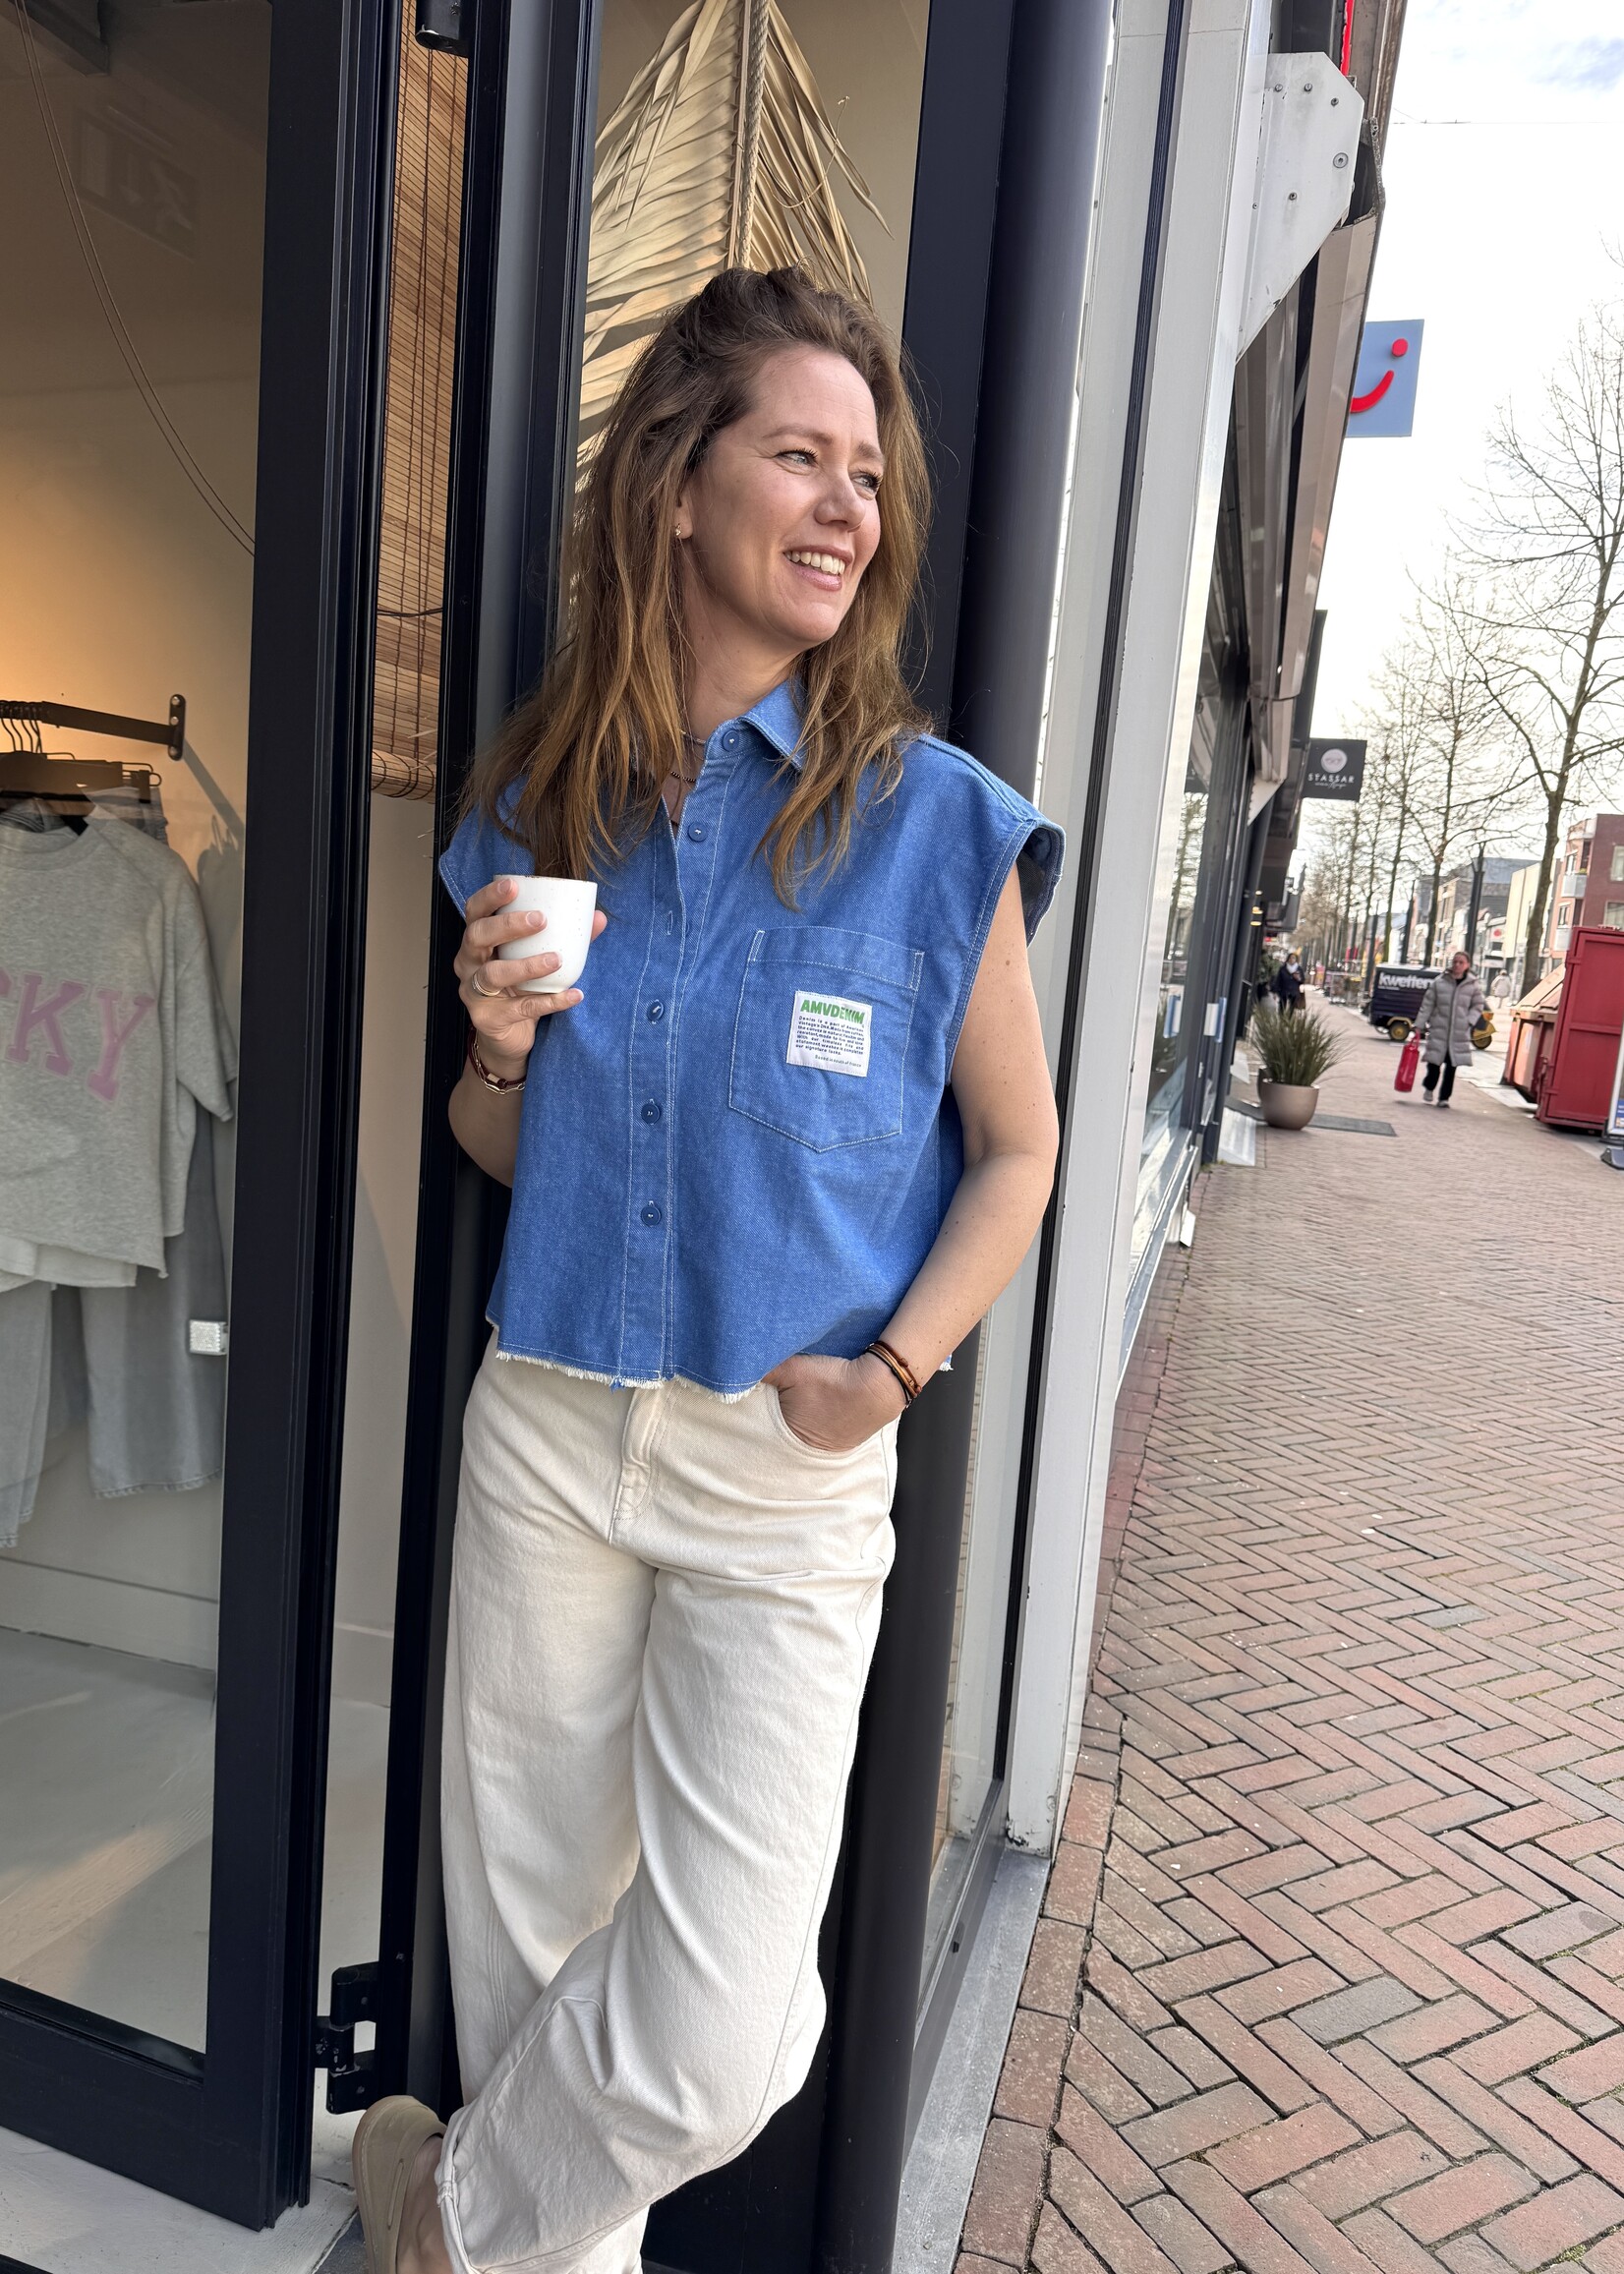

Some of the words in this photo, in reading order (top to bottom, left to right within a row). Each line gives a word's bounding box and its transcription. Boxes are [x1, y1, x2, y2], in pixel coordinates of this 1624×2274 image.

[1307, 772, 1355, 784] STASSAR
[800, 999, 865, 1024] AMVDENIM
[0, 966, 155, 1101] KY
